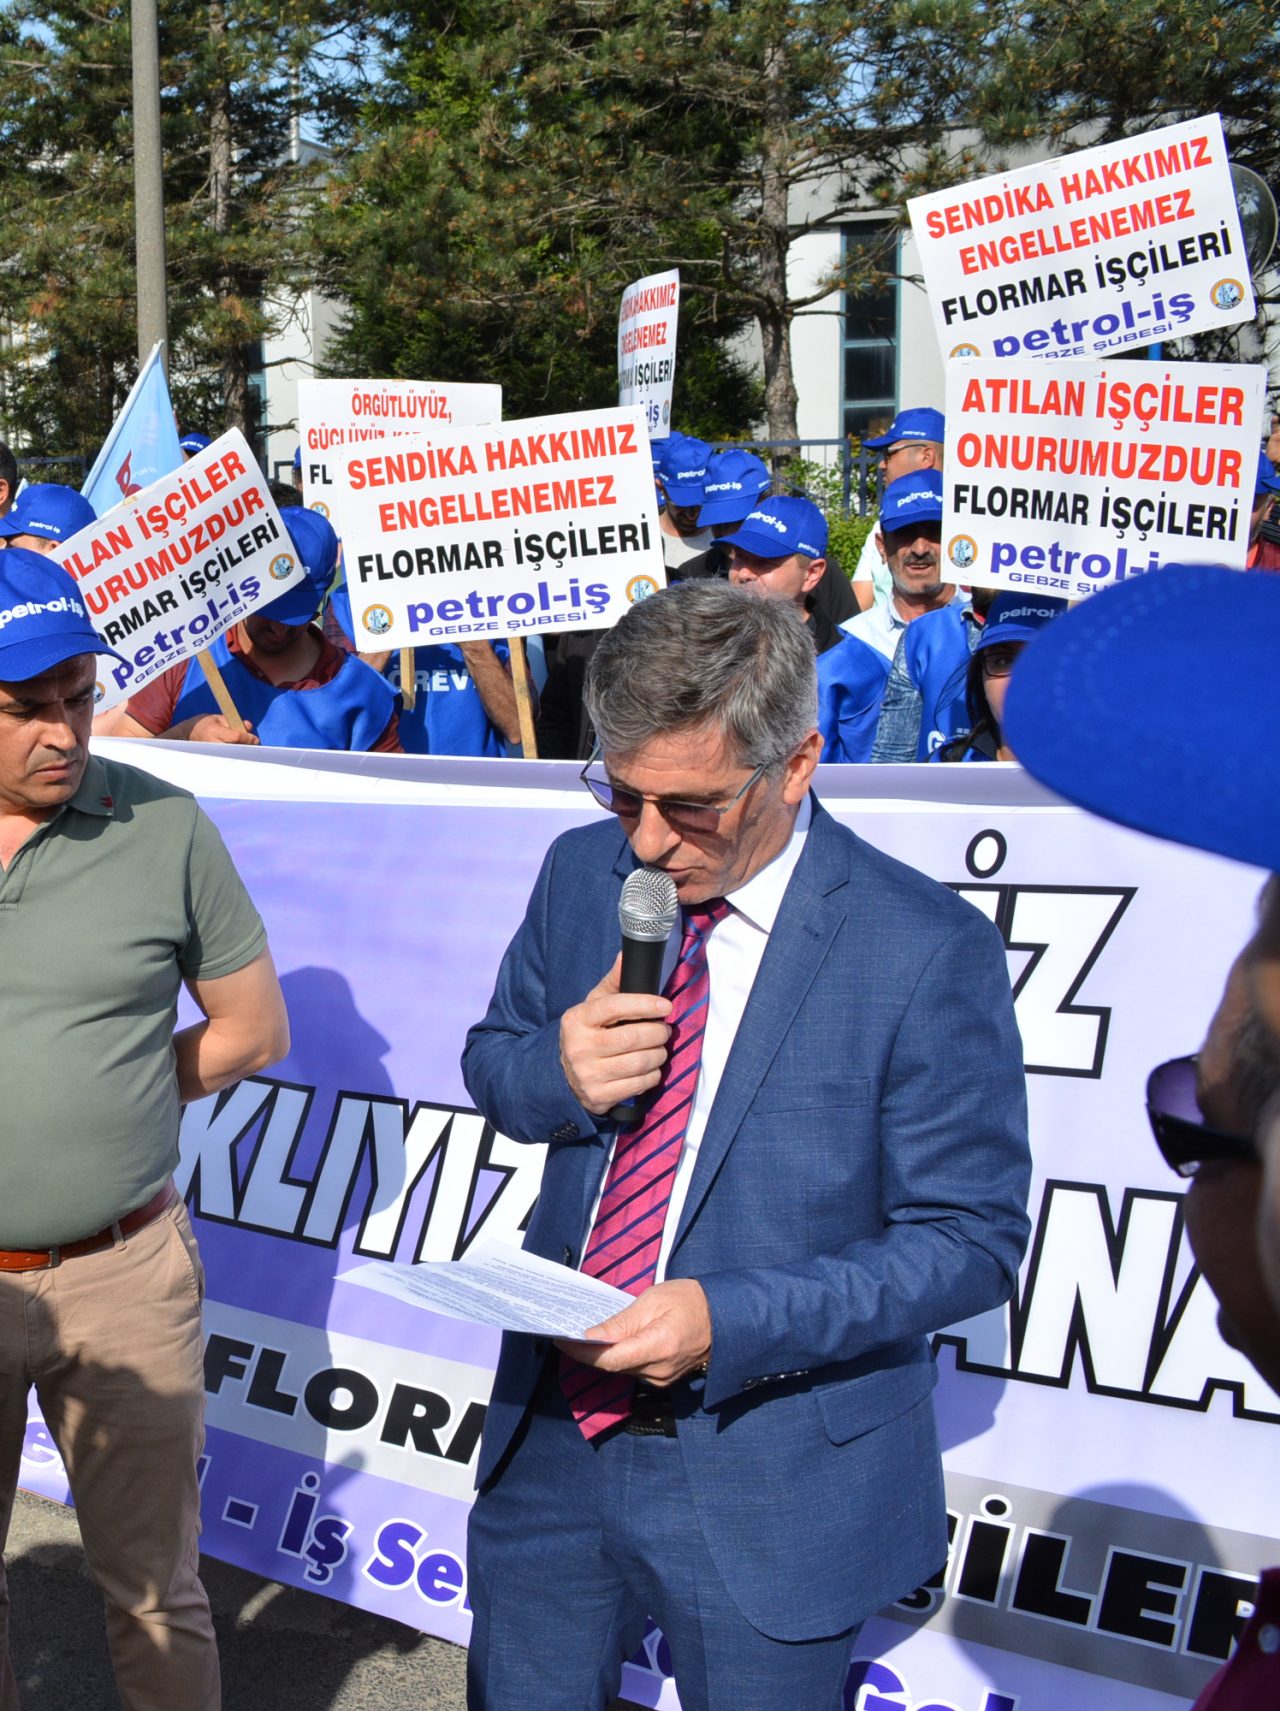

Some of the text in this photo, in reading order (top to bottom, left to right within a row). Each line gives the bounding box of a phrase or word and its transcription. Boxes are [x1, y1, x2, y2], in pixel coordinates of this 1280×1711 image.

[925, 136, 1213, 239] SENDİKA HAKKIMIZ
[959, 189, 1195, 275] ENGELLENEMEZ
[941, 221, 1232, 325] FLORMAR İŞÇİLERİ
[993, 290, 1196, 358] petrol-iş
[1093, 323, 1173, 350] ŞUBESİ
[352, 387, 452, 424] ÖRGÜTLÜYÜZ,
[961, 372, 1244, 431] ATILAN İŞÇİLER
[347, 424, 638, 490] SENDİKA HAKKIMIZ
[957, 433, 1240, 488] ONURUMUZDUR
[134, 451, 246, 541] İŞÇİLER
[378, 475, 617, 532] ENGELLENEMEZ
[953, 484, 1238, 541] FLORMAR İŞÇİLERİ
[178, 512, 280, 600] İŞÇİLERİ
[358, 513, 651, 583] FLORMAR İŞÇİLERİ
[990, 541, 1178, 582] petrol-i
[1008, 572, 1069, 590] GEBZE
[111, 575, 261, 690] petrol-iş
[407, 577, 611, 632] petrol-iş
[429, 610, 588, 636] GEBZE ŞUBESİ
[134, 603, 248, 684] GEBZE ŞUBESİ
[277, 1471, 354, 1585] İş
